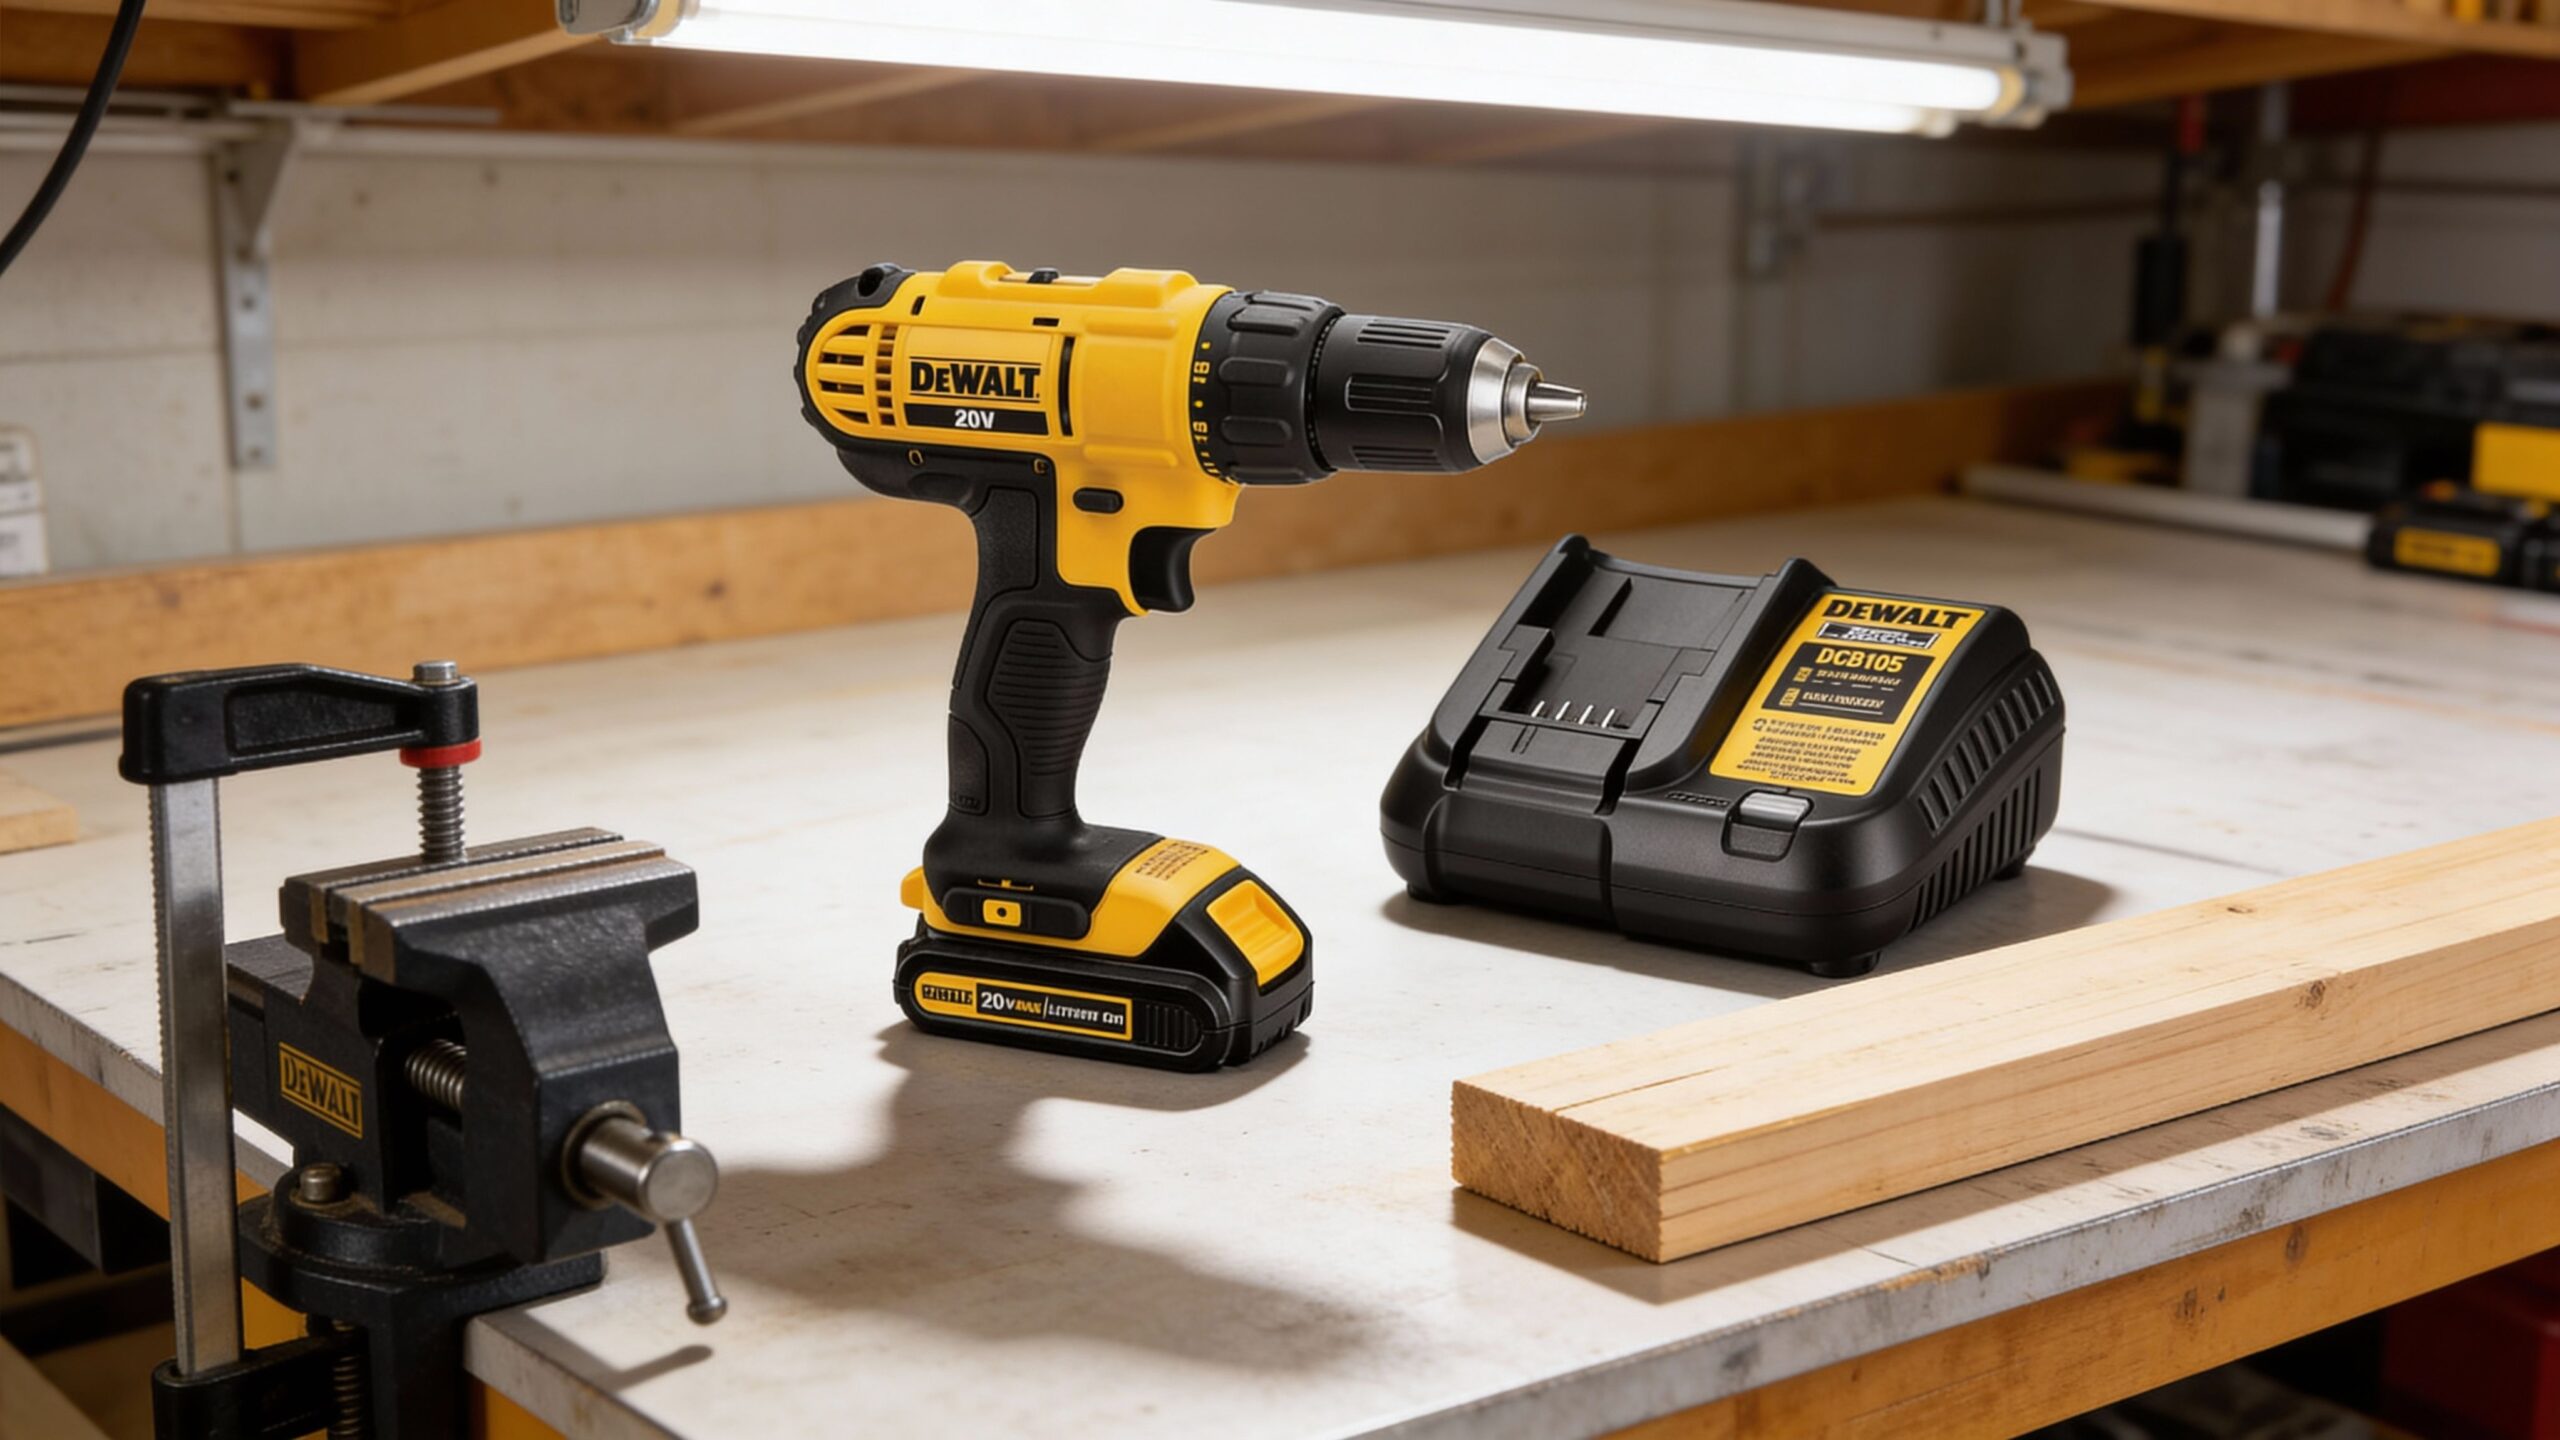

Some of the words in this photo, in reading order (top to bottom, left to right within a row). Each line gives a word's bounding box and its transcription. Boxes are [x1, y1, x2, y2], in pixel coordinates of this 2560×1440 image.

[954, 408, 995, 429] 20V
[1822, 600, 1971, 629] DEWALT
[1815, 648, 1908, 673] DCB105
